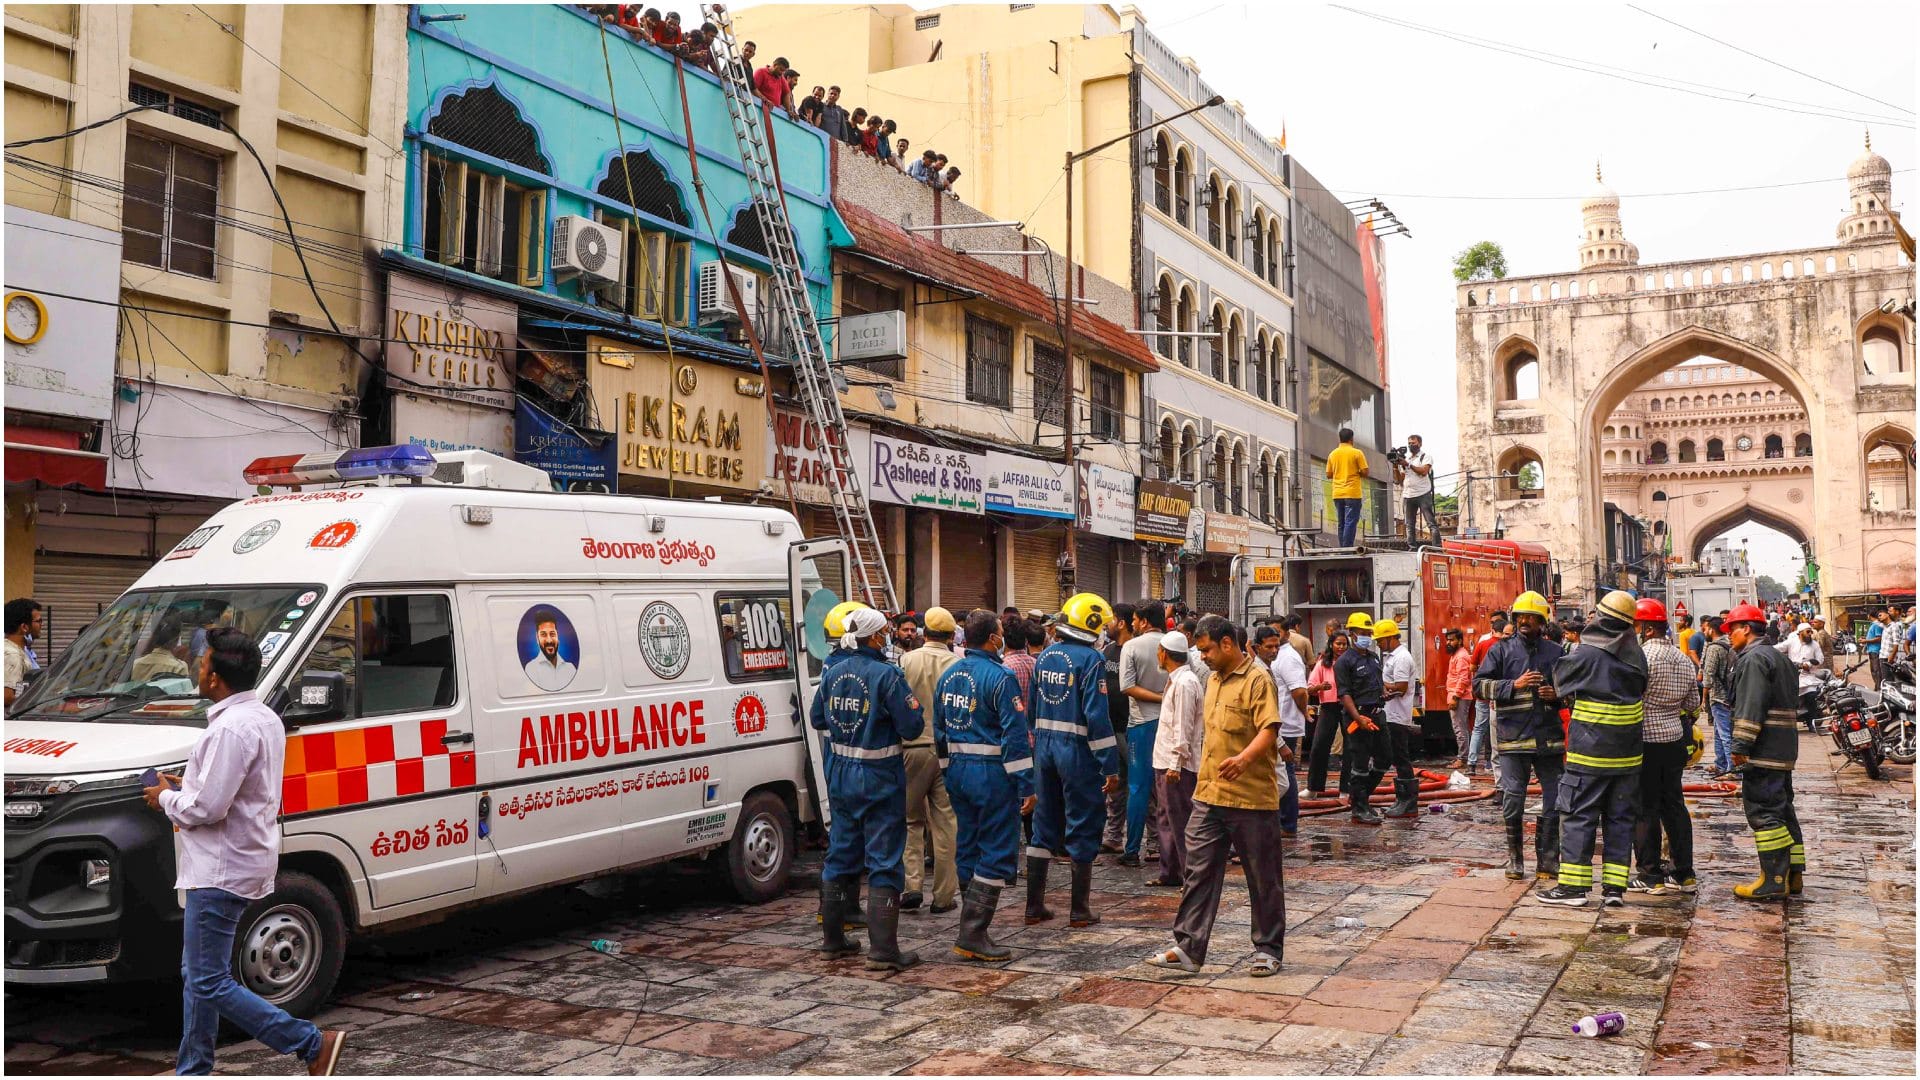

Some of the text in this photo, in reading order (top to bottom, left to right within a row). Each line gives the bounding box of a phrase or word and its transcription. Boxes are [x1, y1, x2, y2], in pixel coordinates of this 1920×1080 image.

[413, 350, 496, 388] PEARLS
[626, 392, 742, 451] IKRAM
[530, 435, 586, 448] KRISHN
[896, 443, 930, 463] రషీద్
[934, 453, 943, 465] &
[624, 442, 744, 482] JEWELLERS
[872, 441, 982, 504] Rasheed & Sons
[1002, 471, 1030, 487] JAFFAR
[1031, 475, 1043, 489] ALI
[1044, 478, 1050, 490] &
[1018, 489, 1048, 501] JEWELLERS
[1139, 492, 1155, 512] SAIF
[1155, 495, 1191, 517] COLLECTION
[581, 537, 716, 567] తెలంగాణ ప్రభుత్వం
[1437, 573, 1449, 588] 101
[740, 620, 750, 649] CALL
[741, 602, 782, 649] 108
[743, 651, 786, 668] EMERGENCY
[1041, 670, 1066, 685] FIRE
[833, 696, 860, 712] FIRE
[944, 693, 969, 709] FIRE
[517, 699, 706, 768] AMBULANCE
[499, 790, 553, 820] అత్యవసర
[621, 772, 645, 794] కాల్
[646, 768, 687, 790] చేయండి
[688, 766, 710, 783] 108
[688, 813, 727, 829] EMRI GREEN
[370, 818, 469, 857] ఉచిత సేవ
